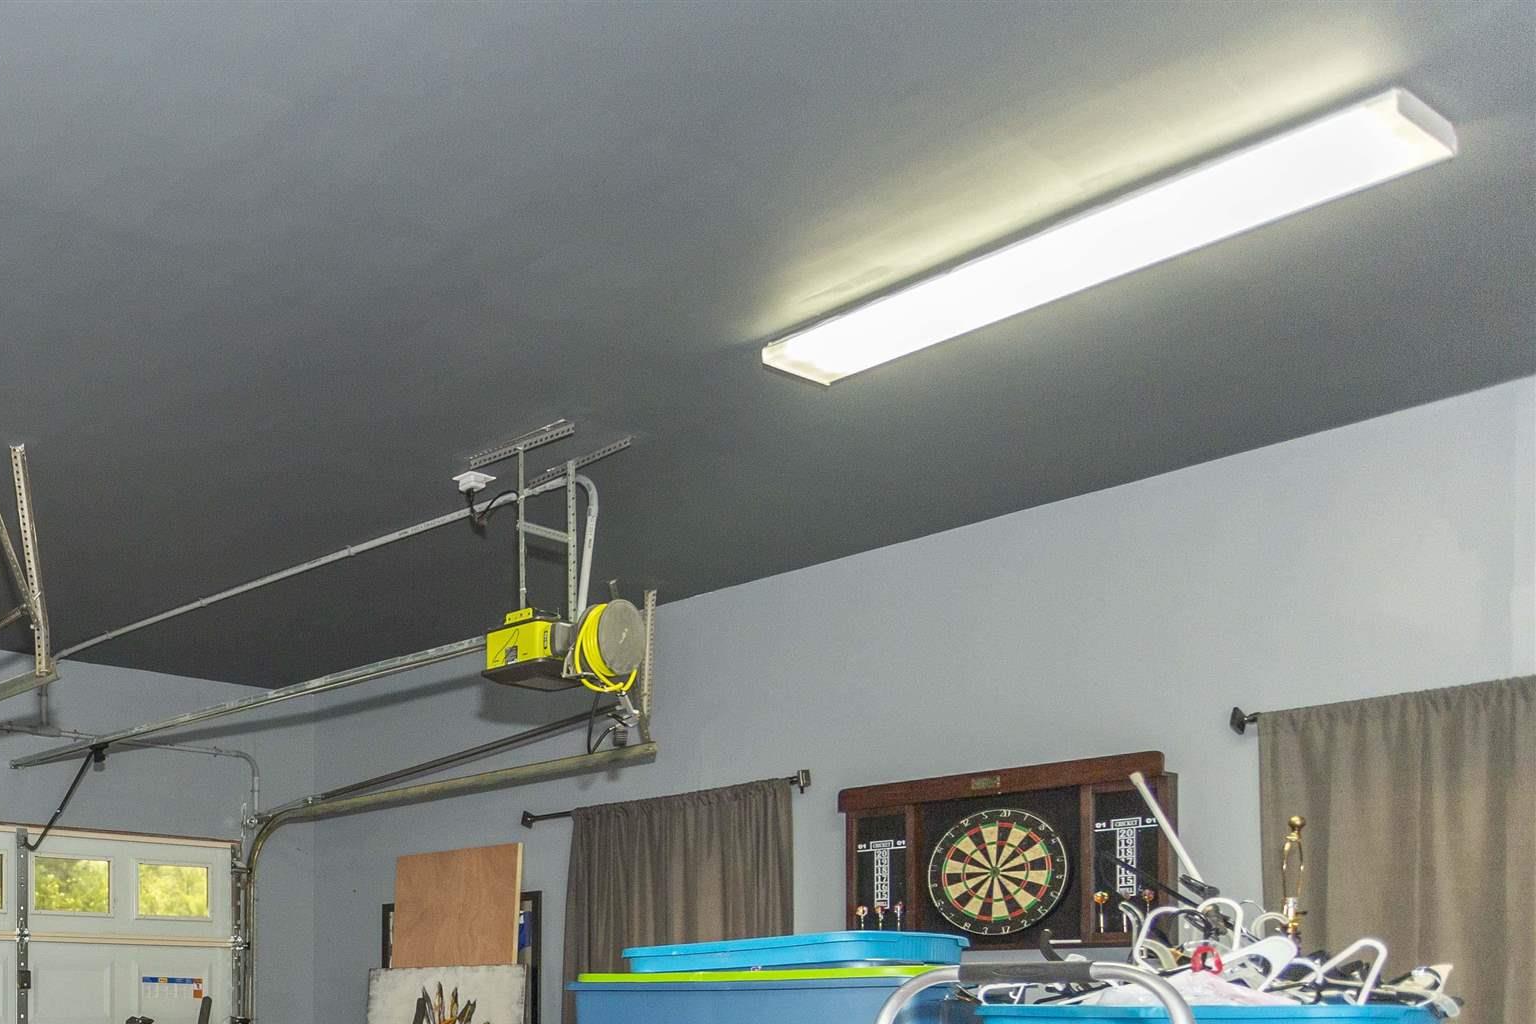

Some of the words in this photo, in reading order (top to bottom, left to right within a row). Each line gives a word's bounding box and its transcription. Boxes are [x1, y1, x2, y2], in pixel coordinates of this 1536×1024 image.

[1119, 829, 1133, 838] 20
[1120, 839, 1133, 848] 19
[1120, 849, 1133, 857] 18
[1120, 876, 1133, 885] 15
